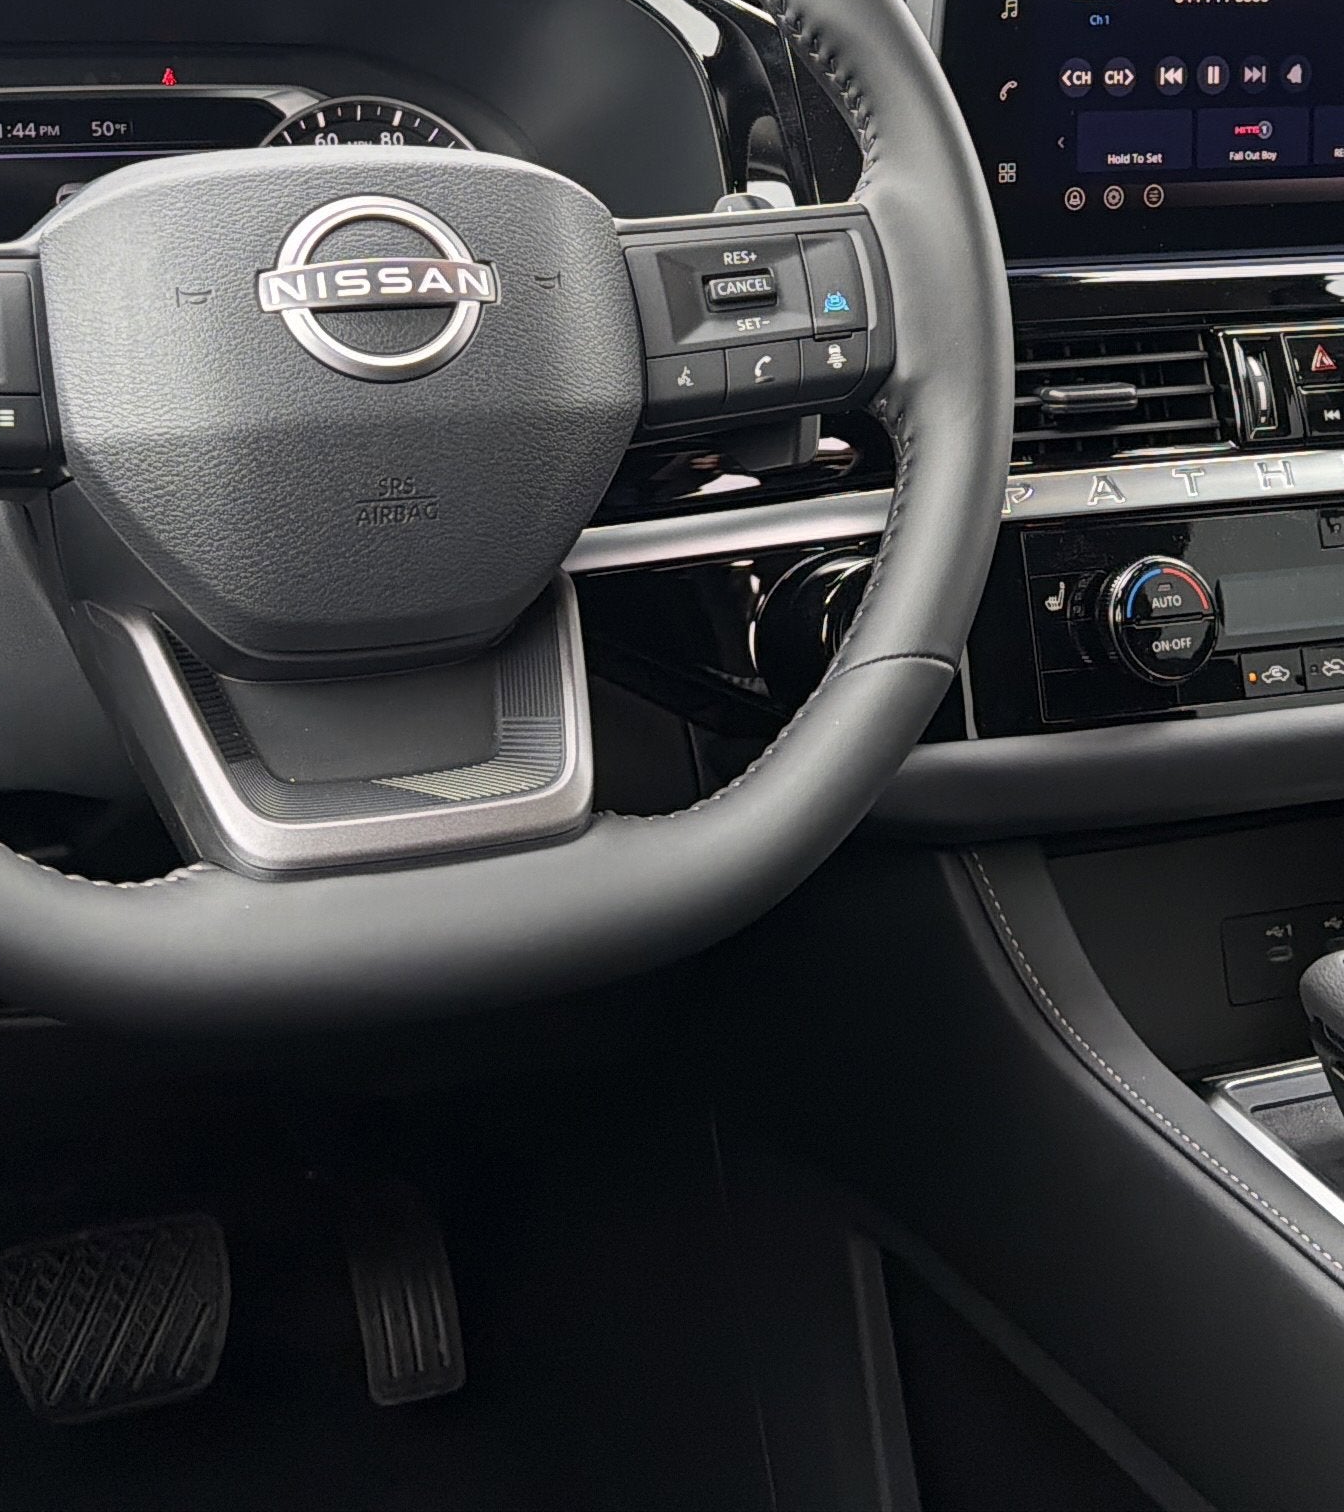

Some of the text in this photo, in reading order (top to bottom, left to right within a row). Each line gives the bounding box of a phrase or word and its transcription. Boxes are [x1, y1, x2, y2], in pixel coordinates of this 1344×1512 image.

[1089, 15, 1110, 26] Ch 1
[39, 125, 61, 136] PM
[380, 131, 405, 146] 80
[1107, 152, 1163, 165] Hold To Set
[268, 265, 493, 305] NISSAN
[716, 278, 772, 296] CANCEL
[377, 476, 416, 496] SRS
[355, 503, 439, 527] AIRBAG
[1152, 594, 1182, 608] AUTO
